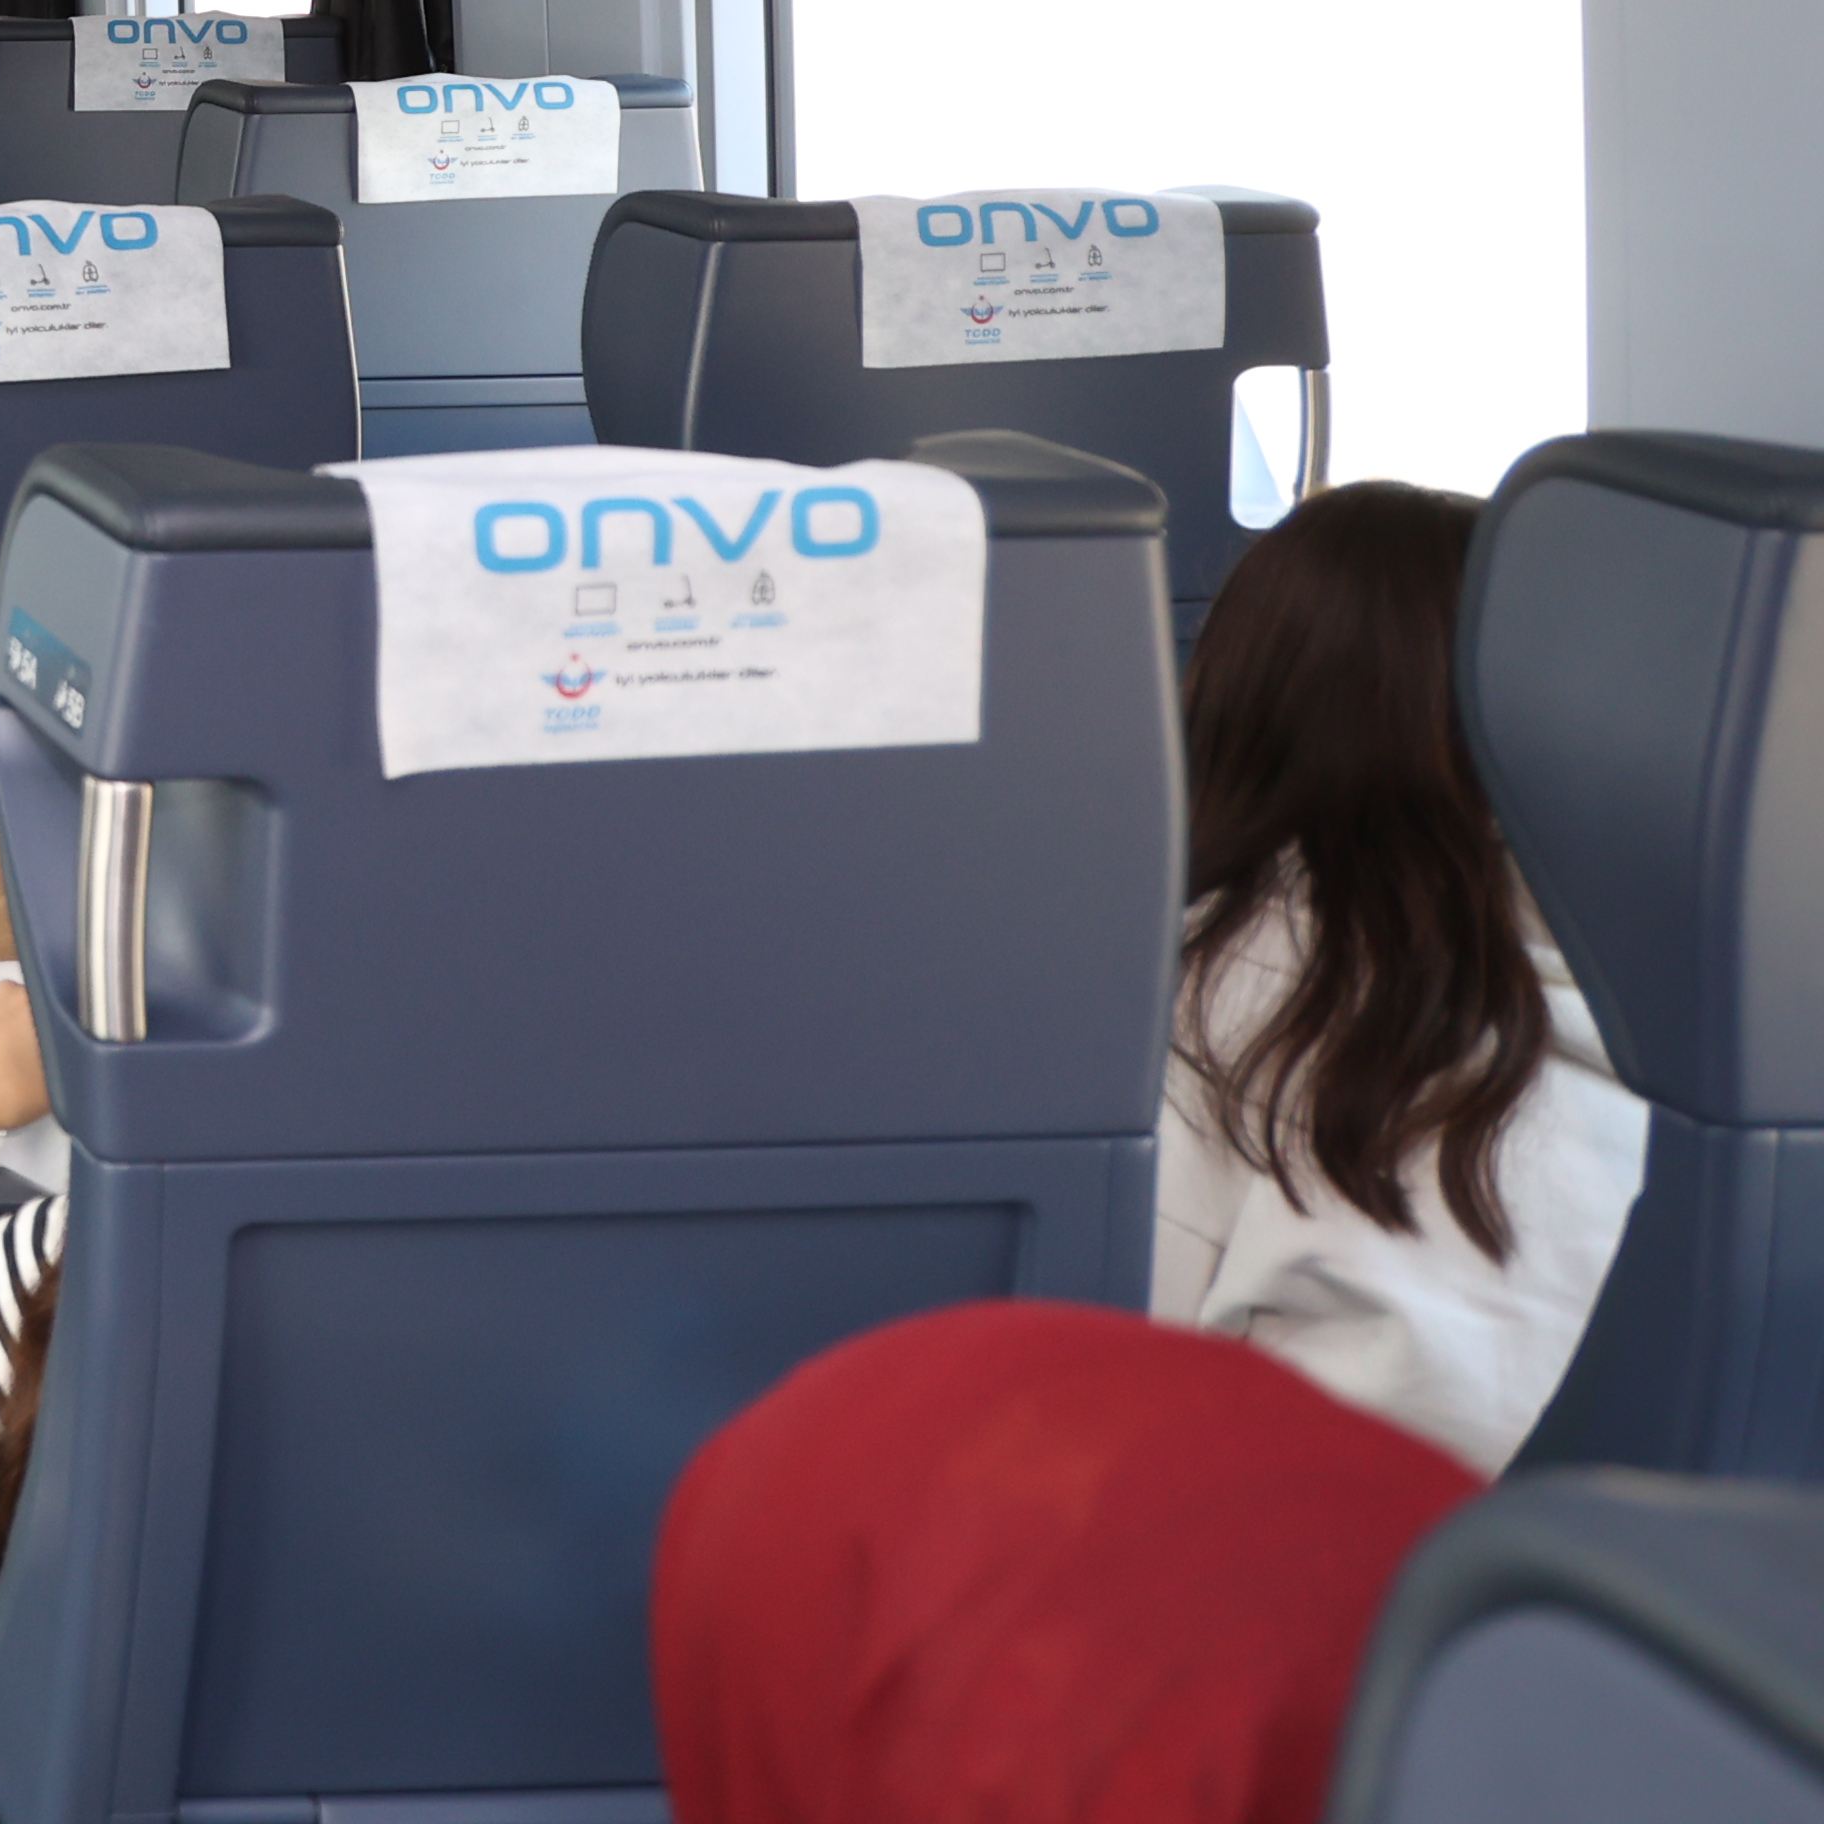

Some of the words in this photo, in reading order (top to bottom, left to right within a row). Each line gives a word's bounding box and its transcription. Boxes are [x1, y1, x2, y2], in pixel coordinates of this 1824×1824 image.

[107, 19, 248, 45] onvo
[397, 81, 574, 115] onvo
[916, 199, 1160, 247] onvo
[965, 328, 1001, 337] TCDD
[473, 486, 881, 575] onvo
